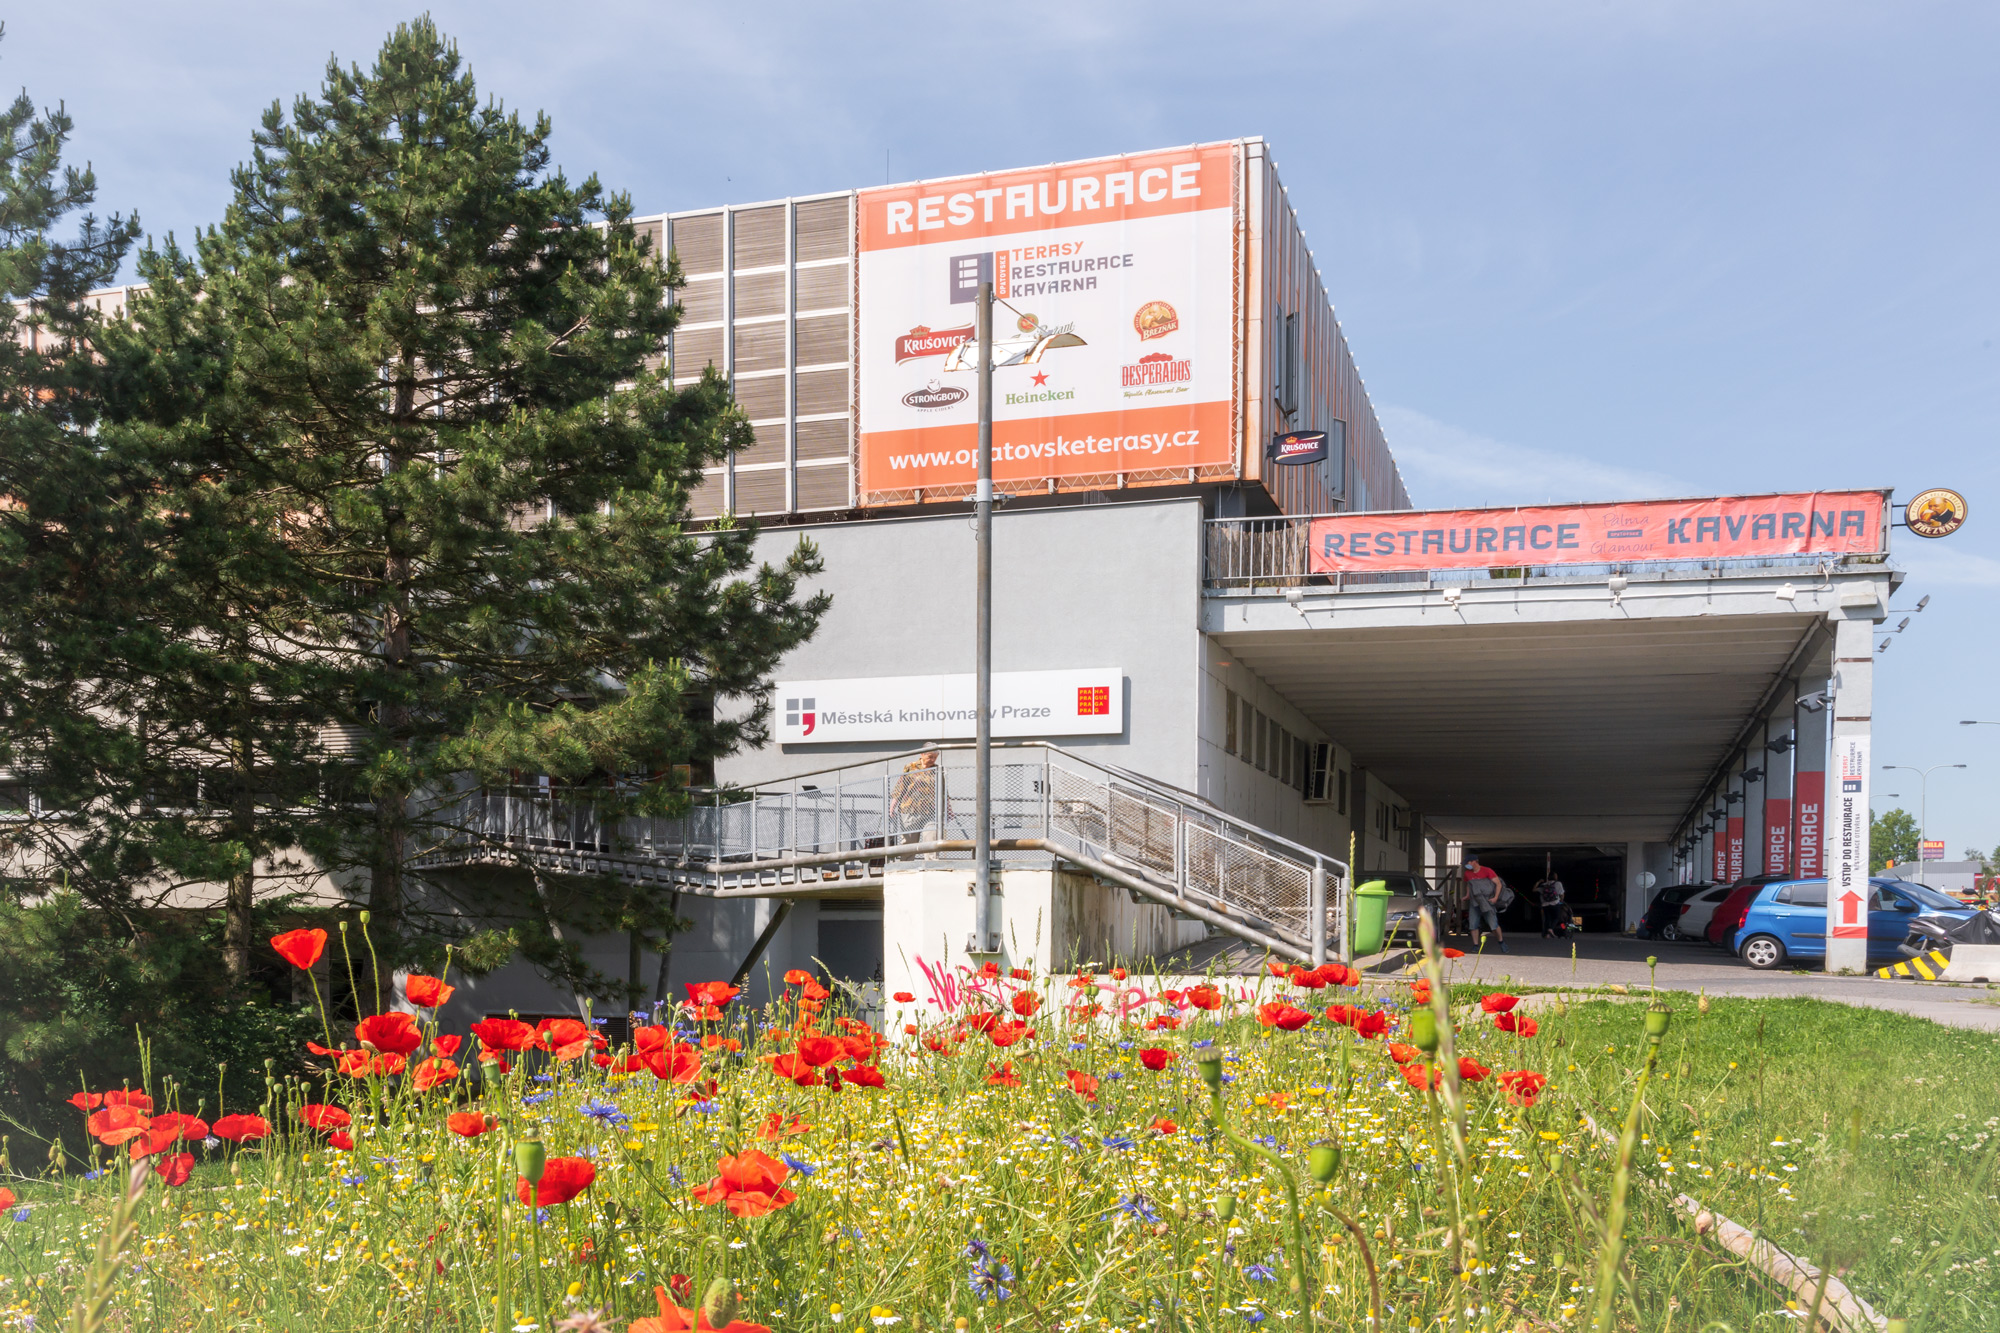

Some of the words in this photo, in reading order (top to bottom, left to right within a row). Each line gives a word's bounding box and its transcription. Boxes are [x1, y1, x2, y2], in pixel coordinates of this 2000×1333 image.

[887, 162, 1201, 235] RESTAURACE
[1012, 241, 1084, 261] TERASY
[1012, 253, 1134, 280] RESTAURACE
[904, 335, 966, 355] KRUŠOVICE
[1122, 360, 1191, 387] DESPERADOS
[908, 391, 962, 405] STRONGBOW
[1005, 389, 1075, 405] Heineken
[1603, 513, 1649, 527] Palma
[1324, 523, 1580, 558] RESTAURACE
[1668, 509, 1866, 545] KAVÁRNA
[1591, 541, 1656, 555] Glamour
[821, 708, 893, 726] Městská
[899, 706, 978, 723] knihovna
[1002, 705, 1051, 719] Praze
[1843, 797, 1853, 847] RESTAURACE
[1770, 826, 1785, 873] URACE
[1800, 803, 1818, 879] TAURACE
[1731, 838, 1743, 882] AURACE
[1842, 849, 1852, 860] DO
[1842, 862, 1852, 887] VSTUP
